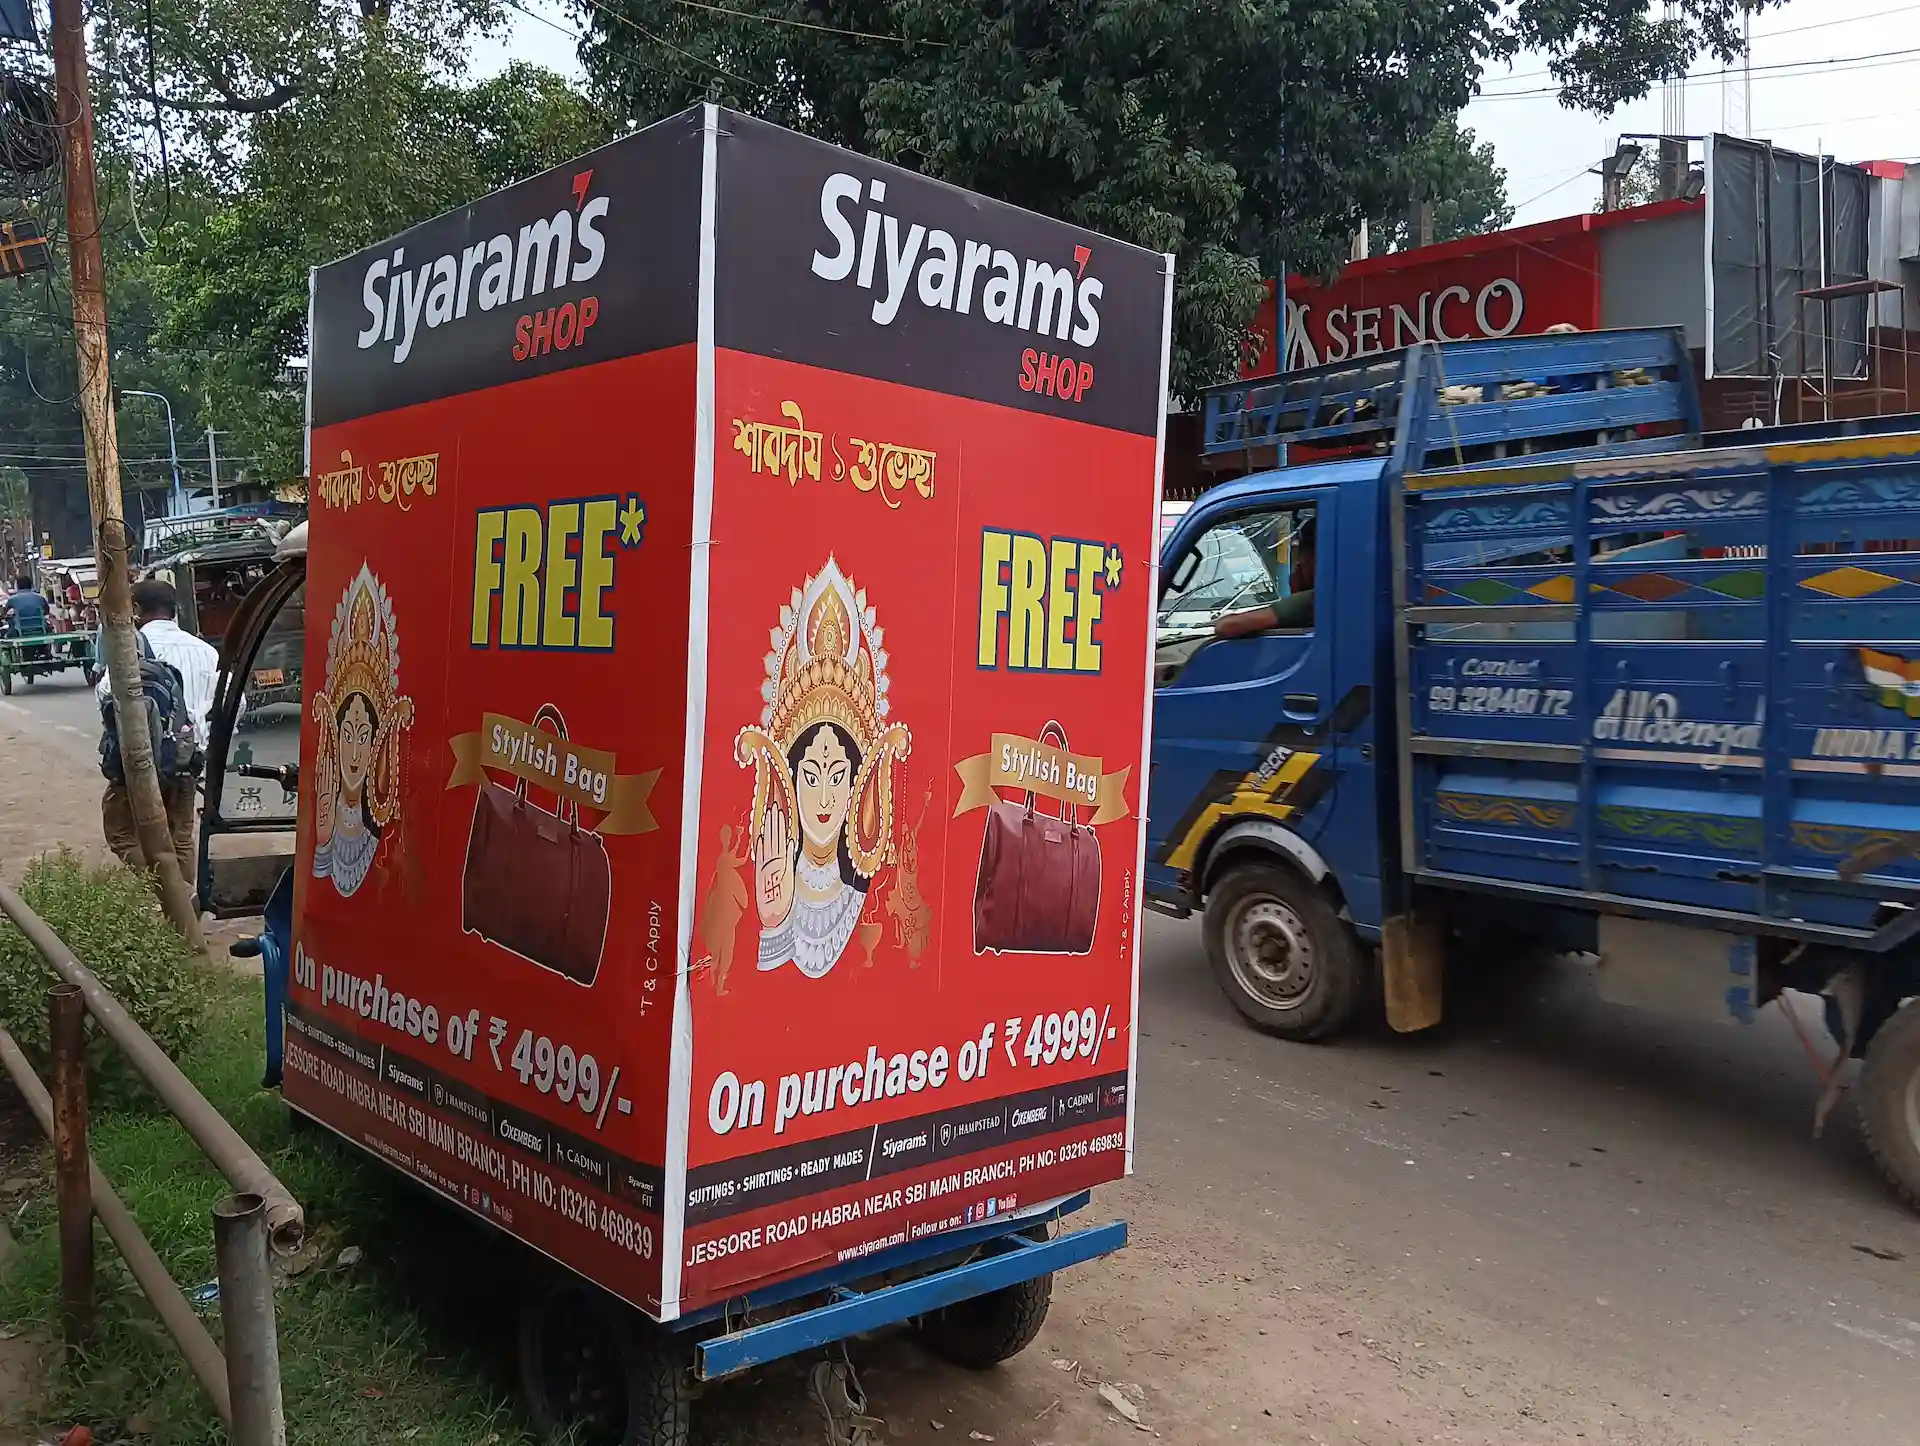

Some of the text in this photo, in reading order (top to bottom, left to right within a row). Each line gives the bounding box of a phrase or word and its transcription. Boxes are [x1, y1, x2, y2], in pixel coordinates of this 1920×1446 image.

[358, 169, 609, 363] Siyaram's
[810, 171, 1104, 348] Siyaram's
[512, 296, 599, 361] SHOP
[1325, 277, 1525, 365] SENCO
[1018, 347, 1094, 402] SHOP
[491, 724, 607, 803] Stylish Bag
[1811, 728, 1907, 760] INDIA
[1001, 743, 1098, 802] Stylish Bag
[1123, 868, 1131, 909] Apply
[647, 901, 661, 953] Apply
[644, 978, 656, 991] &
[646, 957, 658, 971] C
[294, 941, 316, 991] On
[321, 964, 440, 1044] purchase
[447, 1008, 479, 1061] of
[708, 1070, 765, 1134] On
[774, 1044, 949, 1134] purchase
[957, 1021, 996, 1078] of
[1067, 1092, 1094, 1109] CADINI
[1011, 1106, 1048, 1128] OXEMBERG
[286, 1040, 653, 1260] JESSORE ROAD HABRA NEAR SBI MAIN BRANCH, PH NO: 03216 469839
[567, 1148, 602, 1176] CADINI
[688, 1149, 864, 1207] SUITINGS SHIRTINGS READY MADES
[641, 1193, 653, 1208] FIT
[686, 1132, 1124, 1268] JESSORE ROAD HABRA NEAR SBI MAIN BRANCH, PH NO: 03216 469839
[837, 1214, 962, 1263] www.siyaram.com Follow us on:
